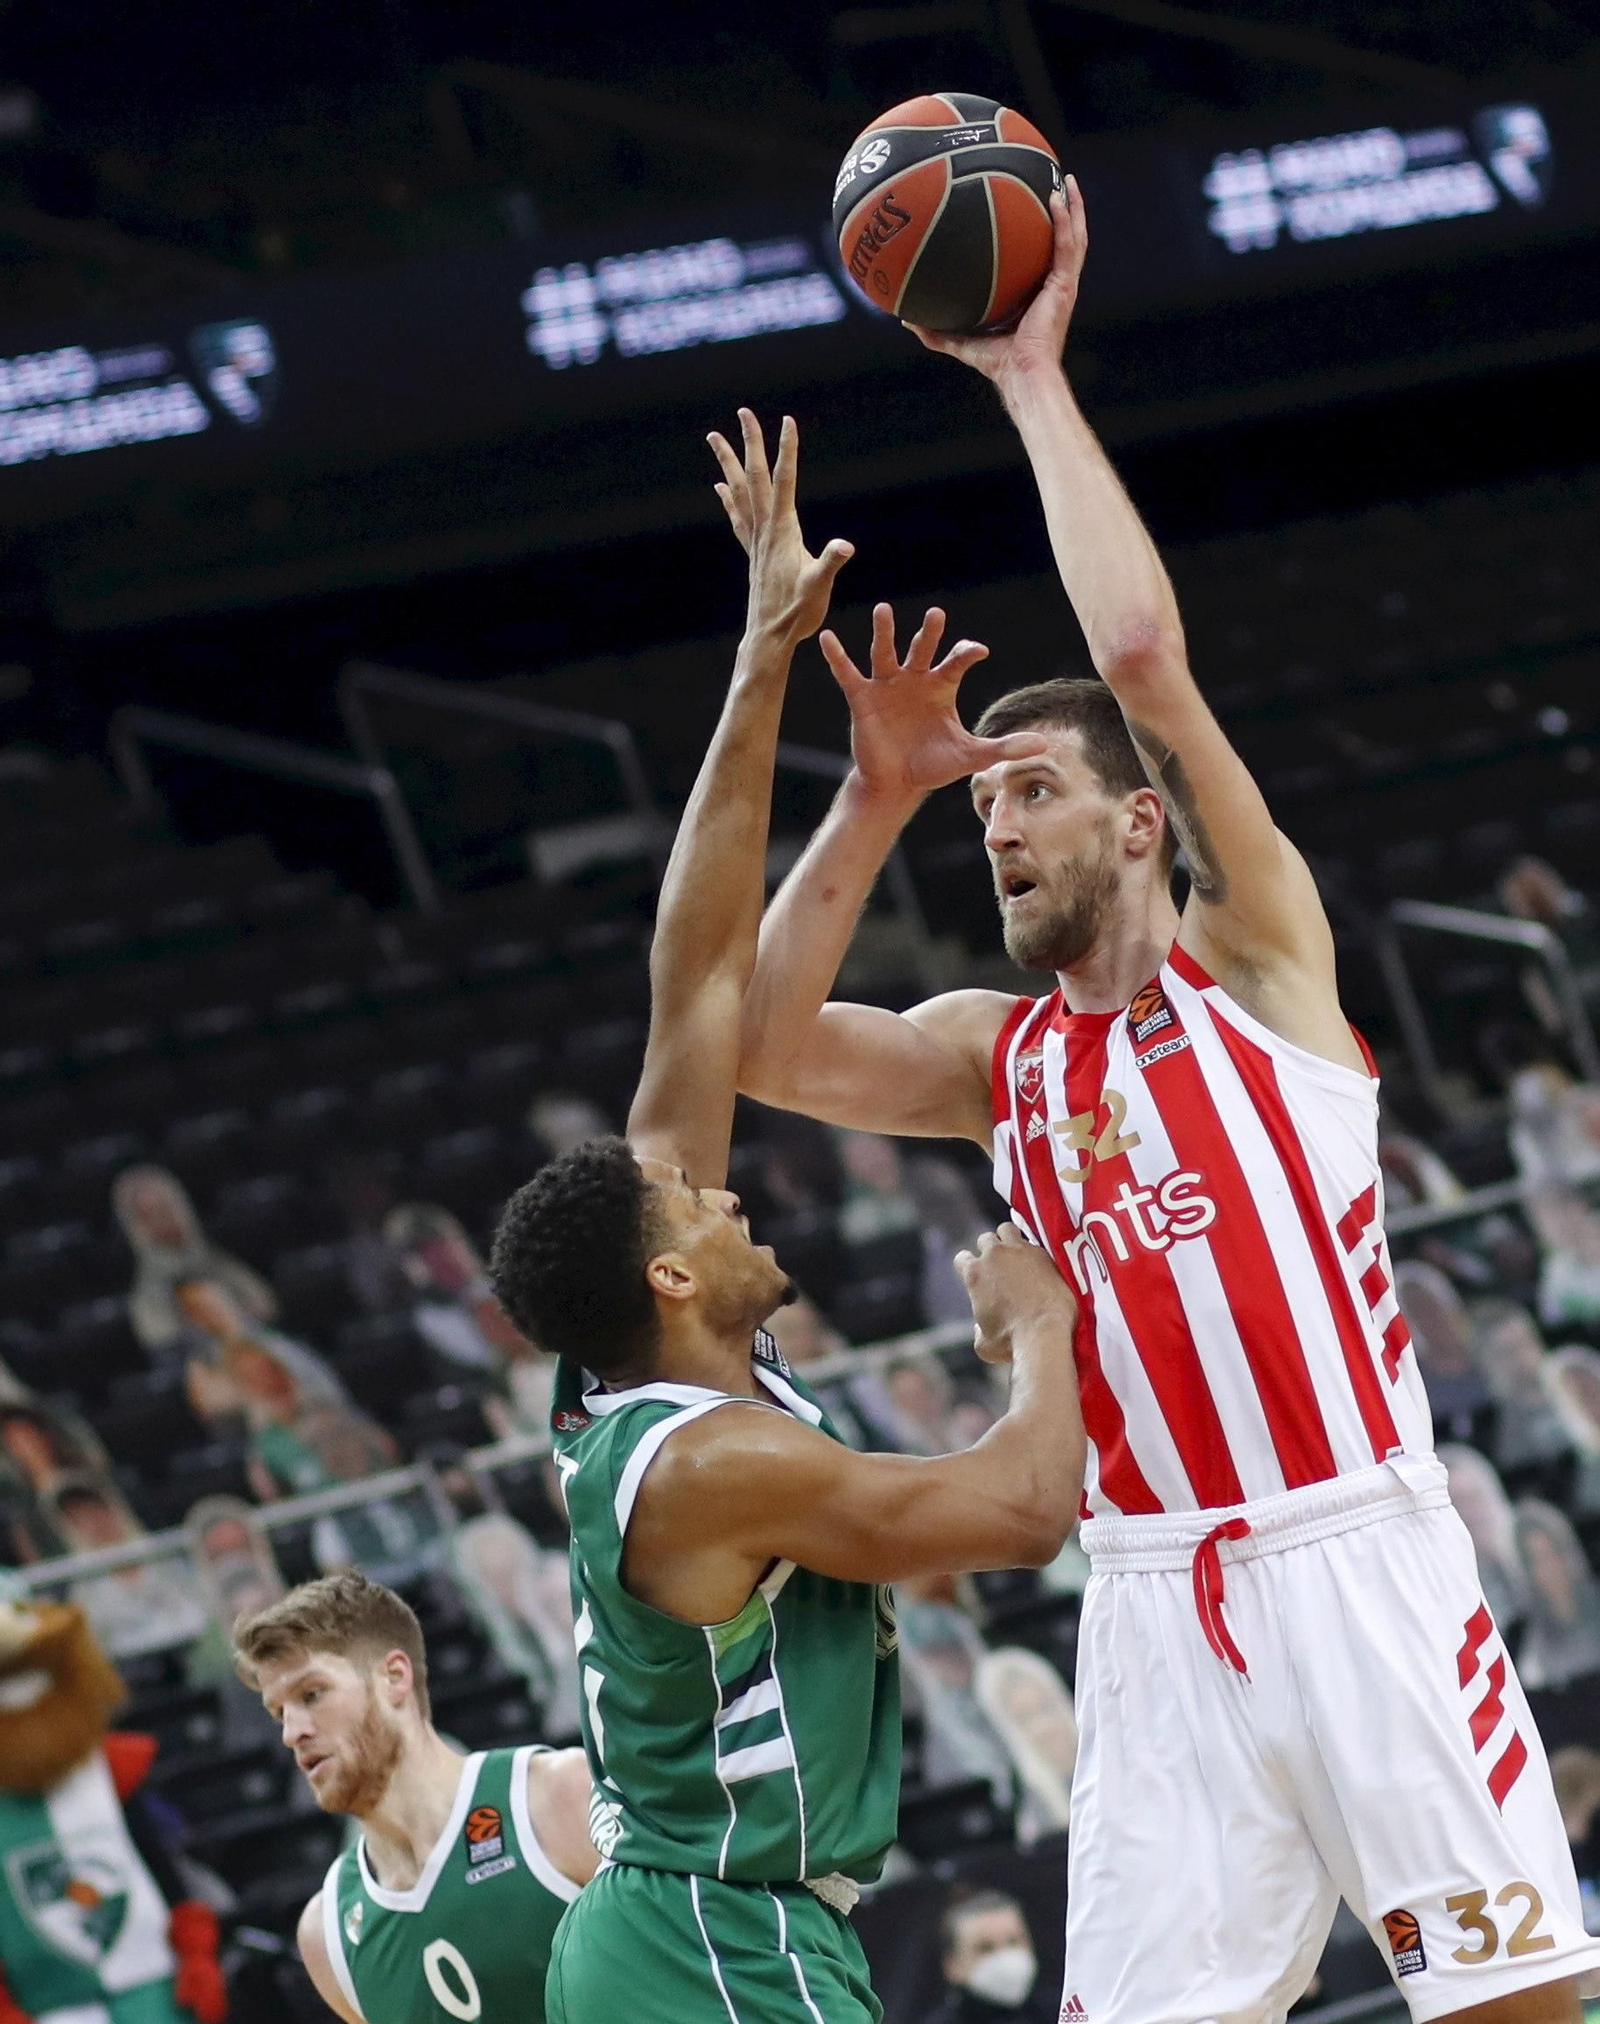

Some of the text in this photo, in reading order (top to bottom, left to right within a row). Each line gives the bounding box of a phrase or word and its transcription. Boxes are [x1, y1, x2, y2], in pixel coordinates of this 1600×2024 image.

[1053, 1089, 1142, 1184] 32
[1063, 1172, 1217, 1296] mts
[1445, 1881, 1556, 1965] 32
[423, 1938, 481, 2022] 0
